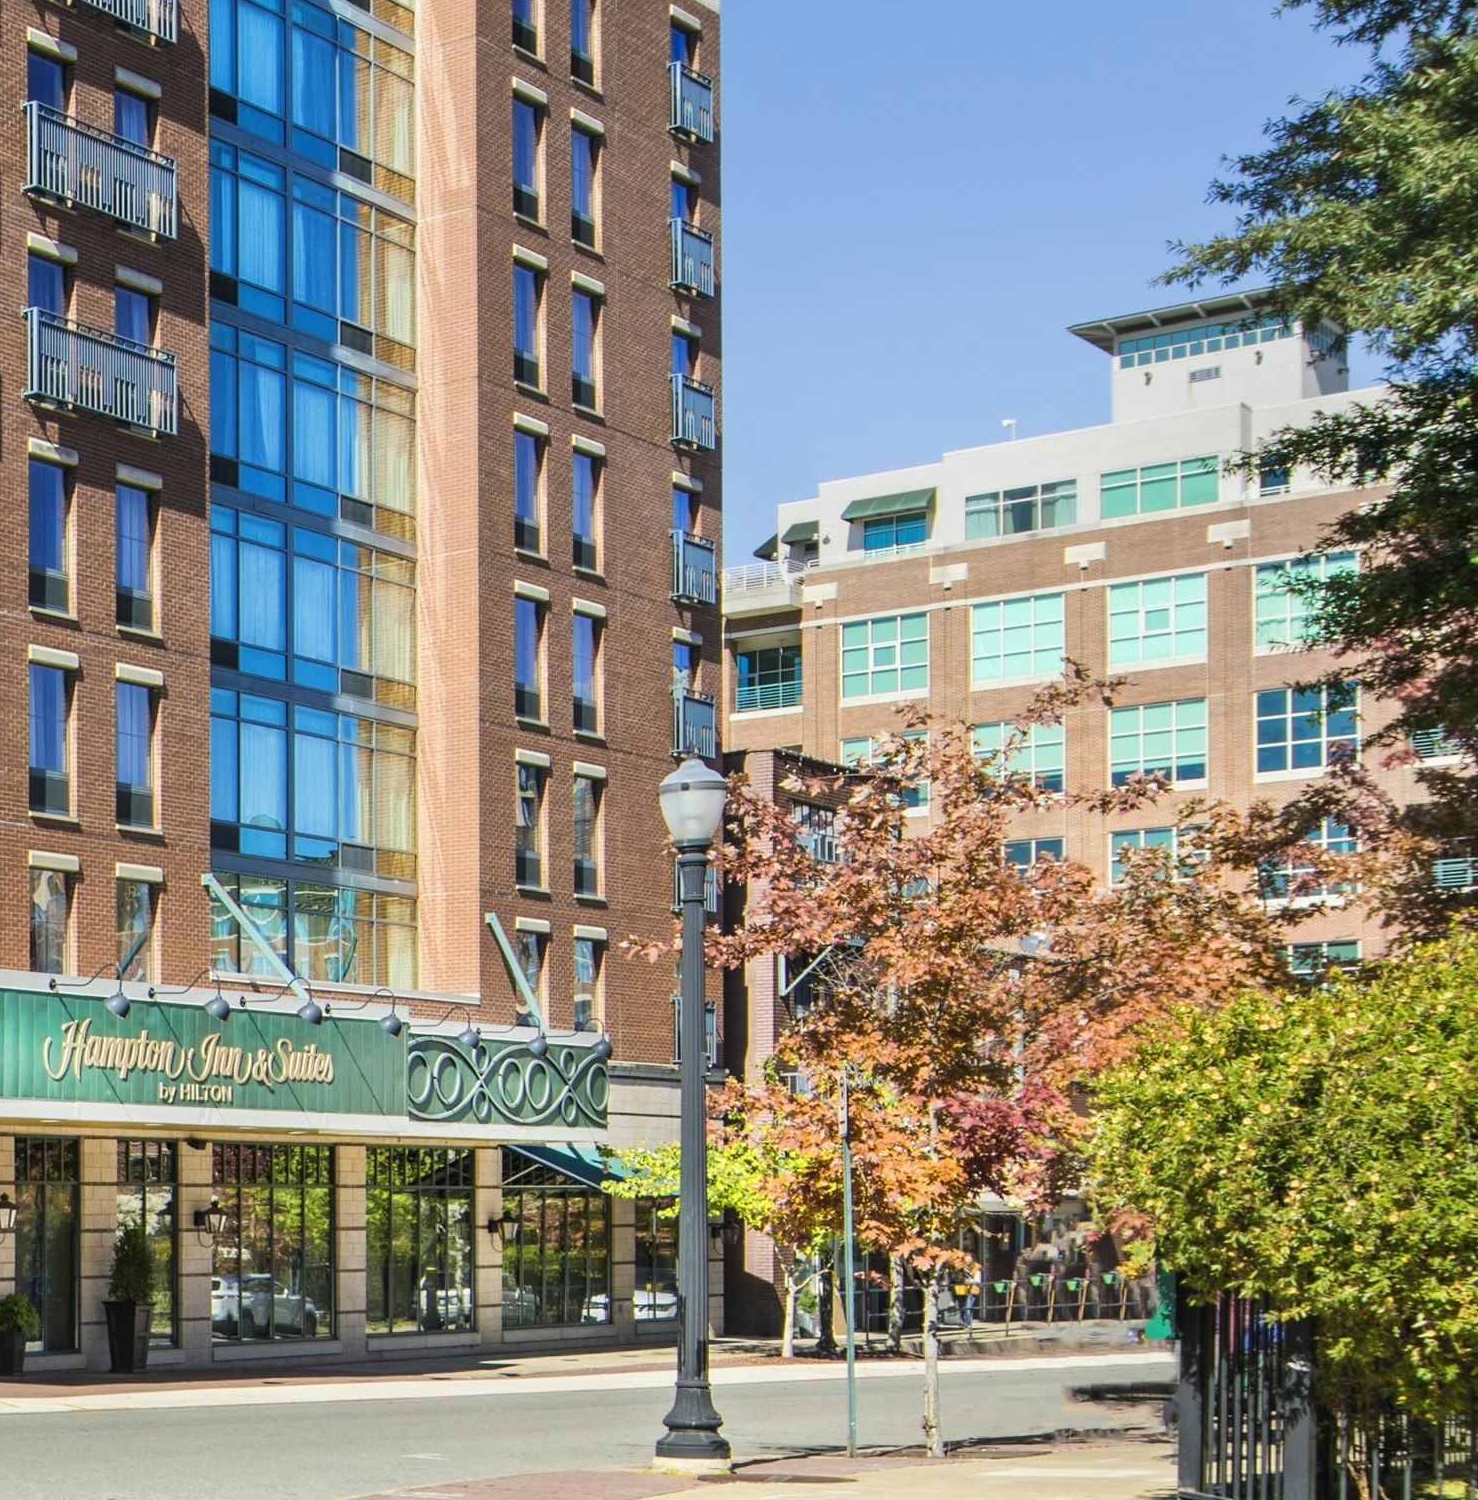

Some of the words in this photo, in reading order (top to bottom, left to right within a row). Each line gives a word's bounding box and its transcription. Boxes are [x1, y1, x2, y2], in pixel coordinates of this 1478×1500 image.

[43, 1018, 185, 1082] Hampton
[187, 1033, 252, 1084] Inn
[252, 1049, 272, 1086] &
[268, 1037, 335, 1083] Suites
[159, 1083, 176, 1104] by
[180, 1083, 233, 1102] HILTON
